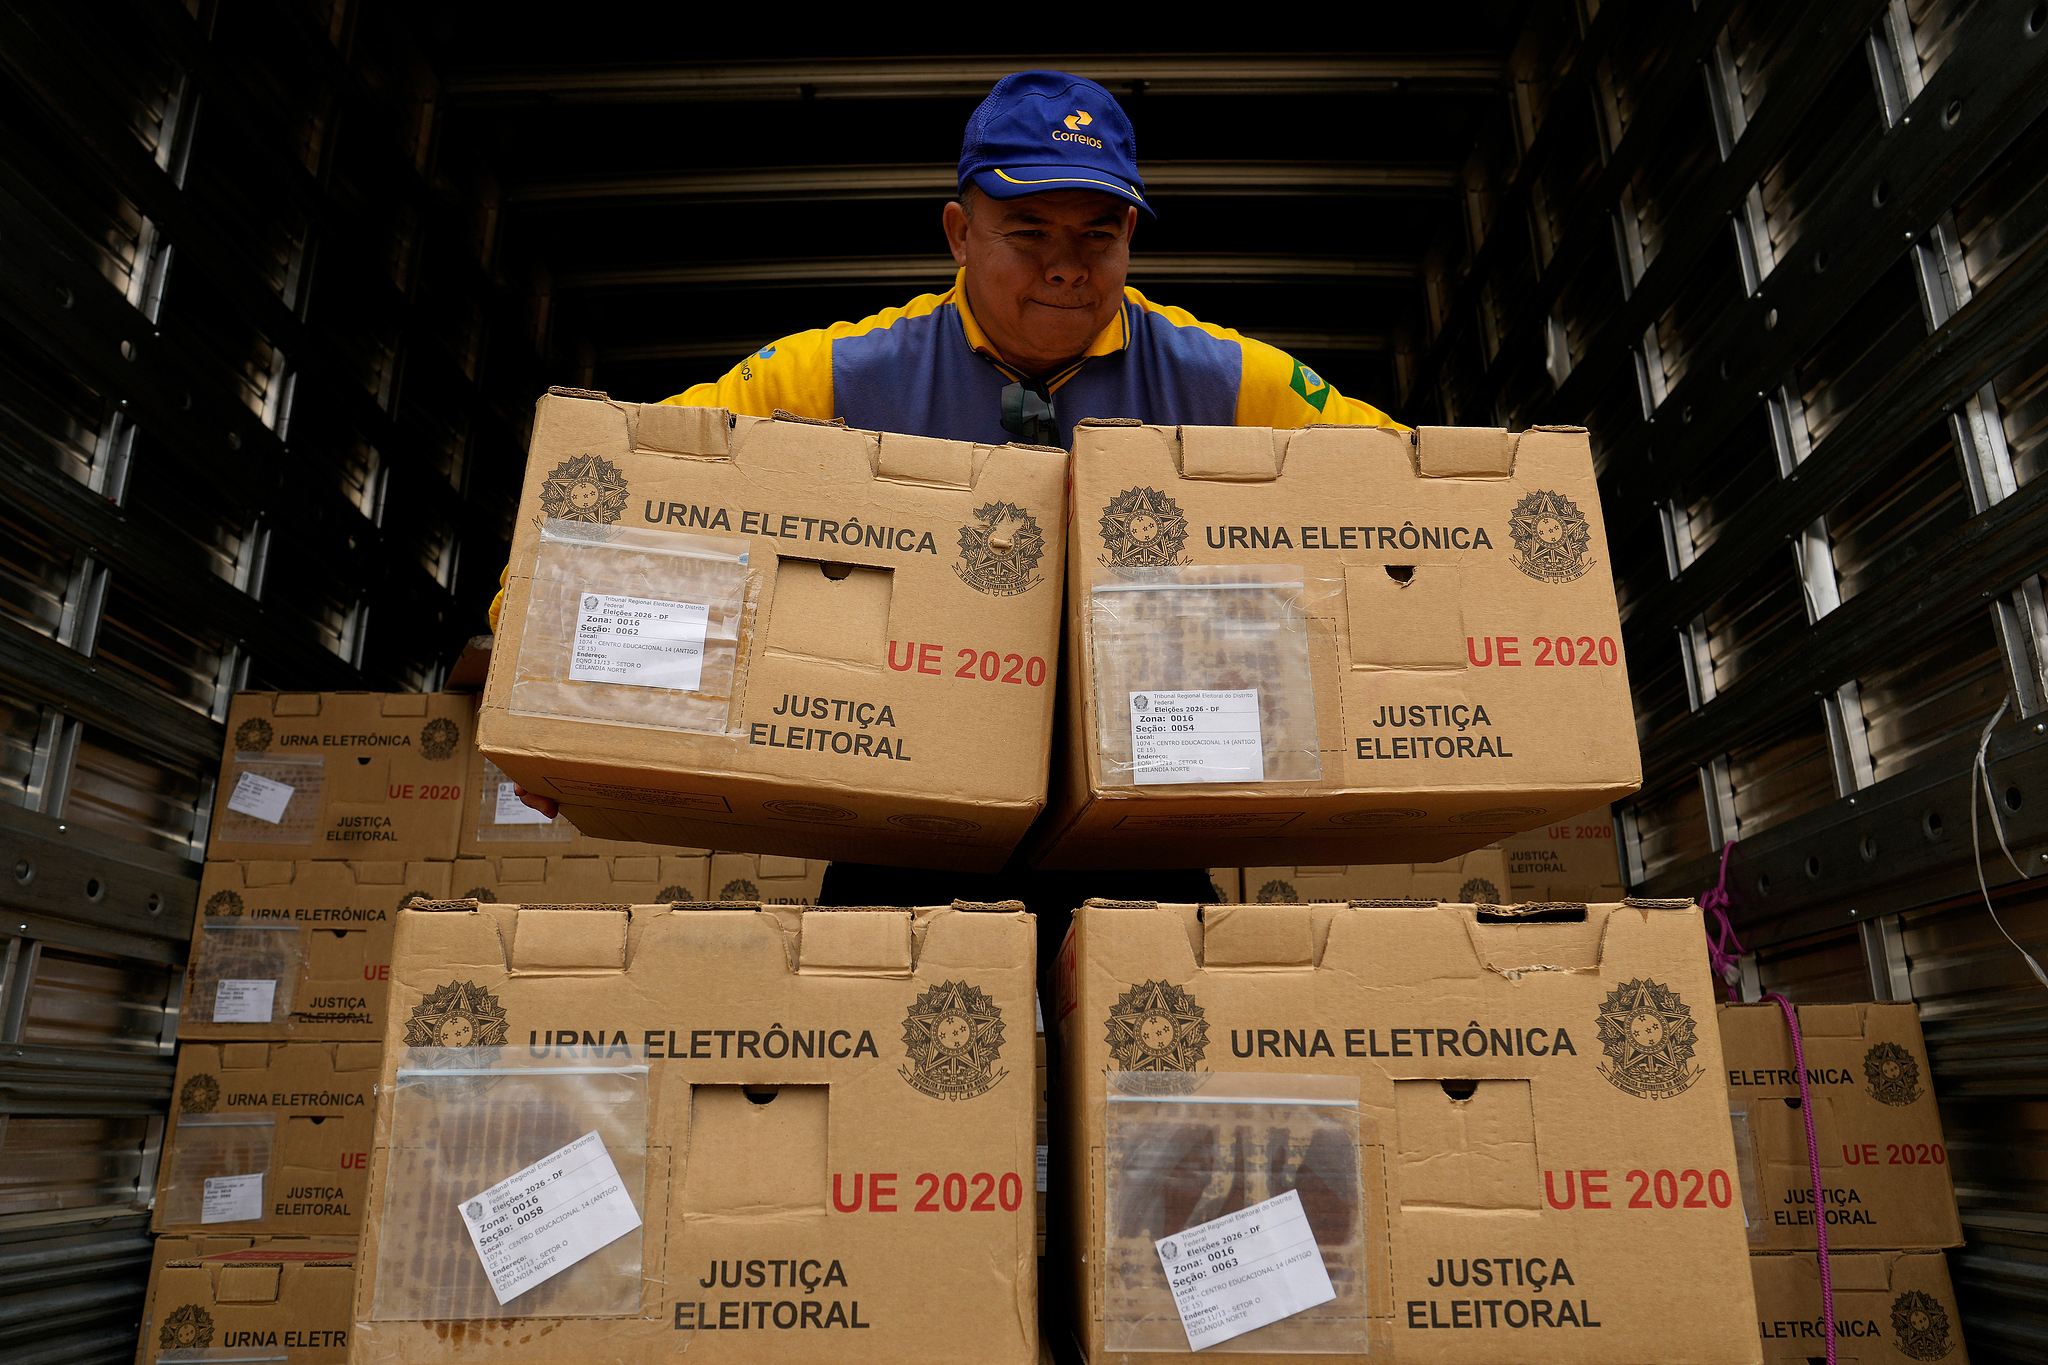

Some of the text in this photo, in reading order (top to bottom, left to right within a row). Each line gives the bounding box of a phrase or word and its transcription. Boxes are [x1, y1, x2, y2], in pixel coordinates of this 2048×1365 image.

[1052, 130, 1102, 149] Correios
[645, 501, 937, 555] URNA ELETRÔNICA
[1206, 521, 1493, 549] URNA ELETRÔNICA
[603, 608, 632, 617] Eleições
[634, 611, 652, 619] 2026
[628, 598, 652, 606] Regional
[652, 600, 676, 608] Eleitoral
[684, 604, 706, 612] Distrito
[586, 615, 640, 627] Zona: 0016
[580, 624, 639, 636] Seção: 0062
[576, 651, 607, 659] Endereço:
[597, 640, 622, 648] CENTRO
[622, 642, 664, 652] EDUCACIONAL
[673, 647, 699, 655] (ANTIGO
[1467, 637, 1617, 667] UE 2020
[574, 663, 627, 674] CEILANDIA NORTE
[889, 641, 1046, 686] UE 2020
[1176, 692, 1201, 700] Regional
[771, 695, 895, 729] JUSTIÇA
[1139, 714, 1194, 723] Zona: 0016
[1154, 706, 1184, 714] Eleições
[1373, 705, 1491, 731] JUSTIÇA
[1135, 724, 1195, 734] Seção: 0054
[281, 733, 410, 746] URNA ELETRÔNICA
[750, 722, 911, 761] ELEITORAL
[1356, 737, 1512, 759] ELEITORAL
[390, 785, 460, 799] UE 2020
[337, 817, 391, 828] JUSTIÇA
[327, 831, 397, 841] ELEITORAL
[1549, 826, 1611, 839] UE 2020
[1510, 851, 1557, 865] JUSTIÇA
[1511, 864, 1566, 873] LEITORAL
[251, 907, 386, 921] URNA ELETRÔNICA
[365, 966, 389, 980] UE
[310, 998, 366, 1010] JUSTIÇA
[529, 1023, 878, 1059] URNA ELETRÔNICA
[1231, 1021, 1577, 1058] URNA ELETRÔNICA
[228, 1091, 364, 1105] URNA ELETRÔNICA
[342, 1153, 366, 1169] UE
[1843, 1144, 1945, 1165] UE 2020
[485, 1135, 595, 1198] Tribunal Regional Eleitoral Distrito
[287, 1188, 343, 1201] JUSTIÇA
[492, 1169, 563, 1214] Eleições 2026 DF
[833, 1173, 1022, 1213] UE 2020
[1545, 1169, 1732, 1209] UE 2020
[488, 1190, 511, 1206] Federal
[276, 1204, 350, 1215] ELEITORAL
[479, 1195, 539, 1234] Zona: 0016
[1181, 1195, 1293, 1240] Tribunal Regional Eleitoral Distrito
[1774, 1210, 1876, 1225] ELEIORAL
[479, 1206, 544, 1247] Seção: 0058
[486, 1250, 503, 1262] 1074
[508, 1232, 534, 1250] CENTRO
[534, 1207, 581, 1236] EDUCACIONAL
[590, 1185, 618, 1205] (ANTIGO
[483, 1240, 504, 1255] Local:
[1183, 1235, 1207, 1248] Federal
[1186, 1224, 1261, 1257] Eleições 2026 DF
[539, 1243, 562, 1260] SETOR
[492, 1255, 527, 1277] Endereço:
[1173, 1246, 1234, 1275] Zona: 0016
[498, 1255, 556, 1292] CEILANDIA NORTE
[700, 1260, 847, 1294] JUSTIÇA
[1172, 1258, 1239, 1288] Seção: 0063
[1179, 1294, 1195, 1305] 1074
[1200, 1282, 1228, 1297] CENTRO
[1228, 1266, 1274, 1287] EDUCACIONAL
[1284, 1250, 1312, 1267] (ANTIGO
[1428, 1258, 1574, 1292] JUSTIÇA
[1175, 1285, 1197, 1298] Local:
[1184, 1304, 1219, 1321] Endereço:
[1231, 1299, 1254, 1312] SETOR
[1407, 1300, 1601, 1328] ELEITORAL
[675, 1301, 869, 1329] ELEITORAL
[1189, 1310, 1248, 1338] CEILANDIA NORTE
[1762, 1317, 1881, 1338] LETRÔNICA
[225, 1331, 348, 1347] URNA ELETR
